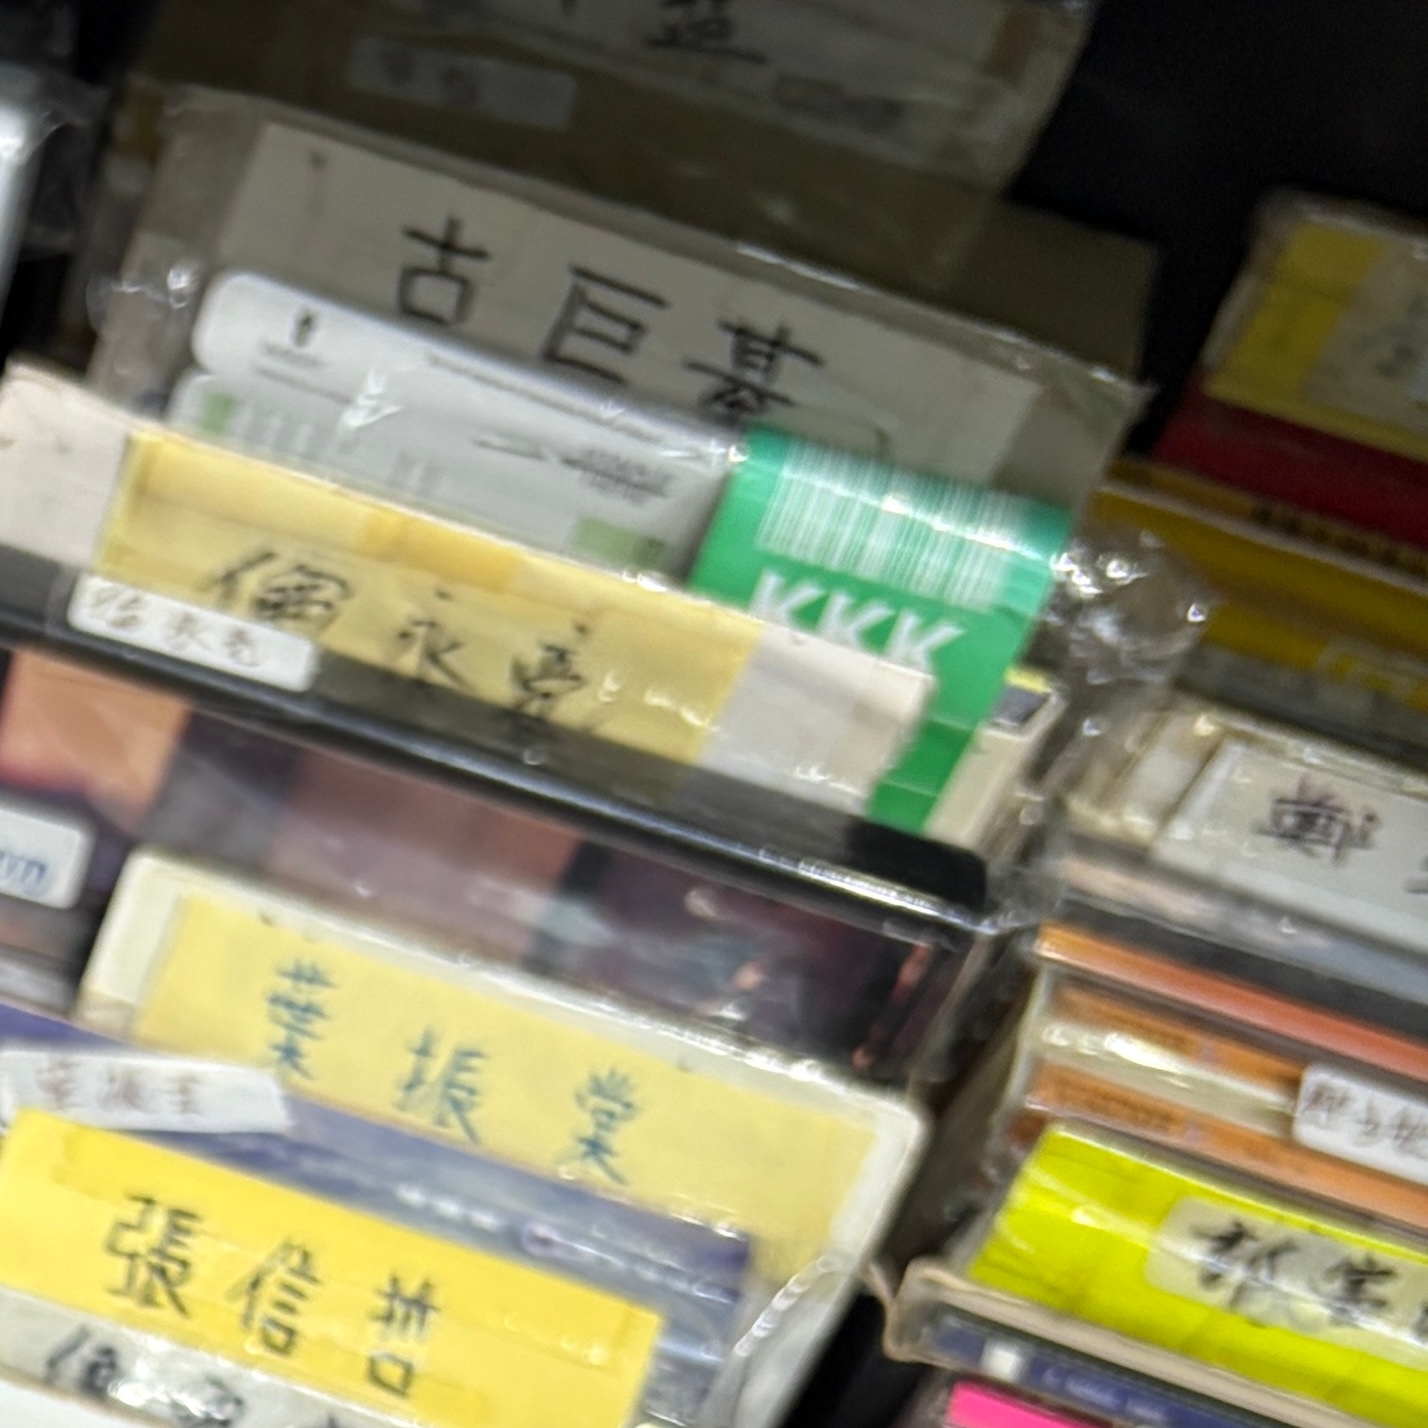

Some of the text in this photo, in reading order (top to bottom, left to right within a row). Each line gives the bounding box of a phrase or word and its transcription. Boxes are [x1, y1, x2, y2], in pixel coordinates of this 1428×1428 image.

[394, 214, 824, 428] 古巨基
[104, 1192, 442, 1400] 張信哲
